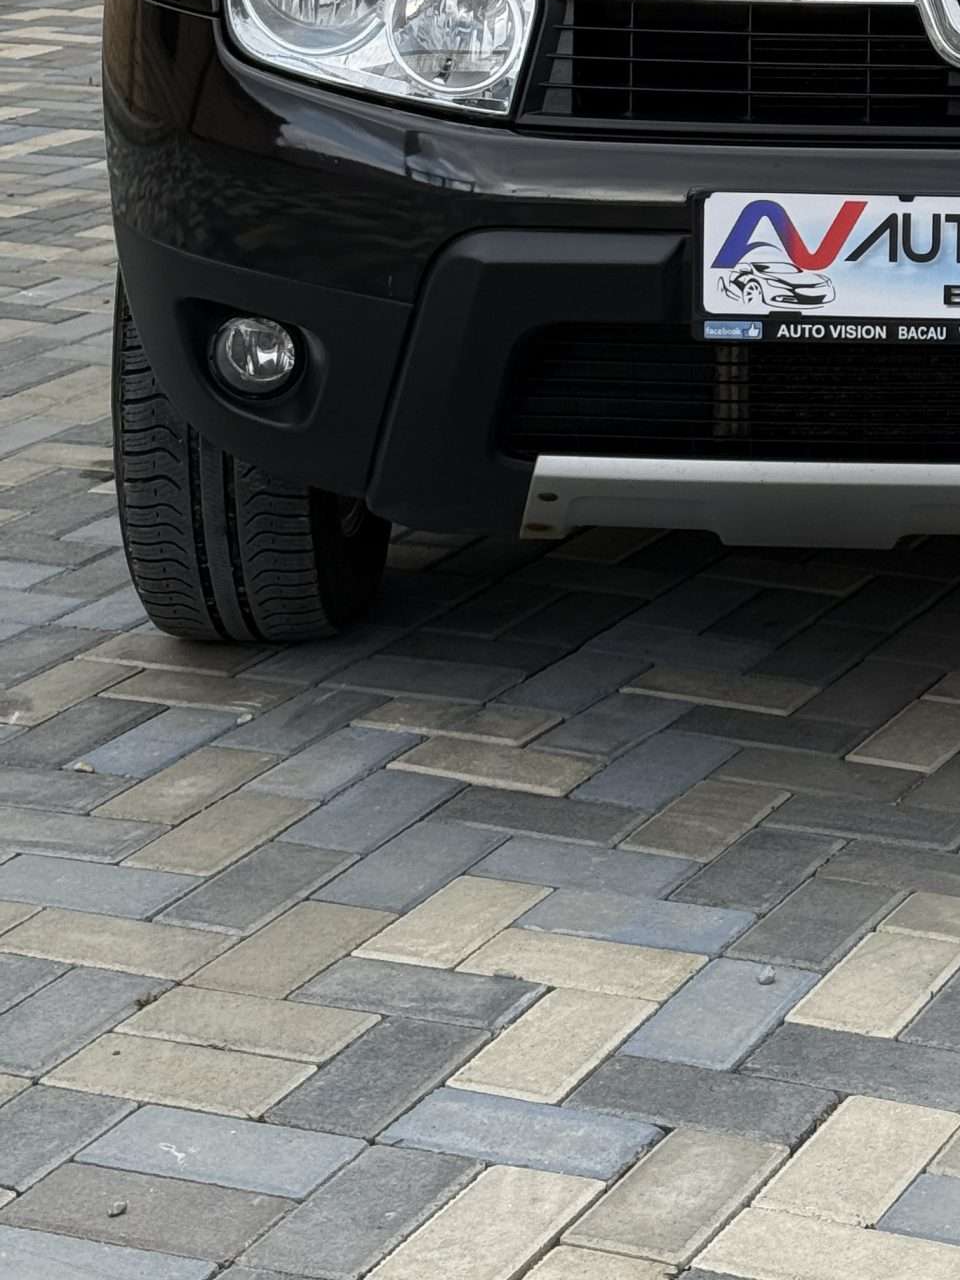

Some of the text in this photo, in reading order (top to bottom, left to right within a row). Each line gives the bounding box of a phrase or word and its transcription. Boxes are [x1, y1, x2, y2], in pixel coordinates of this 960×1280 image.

[777, 324, 826, 339] AUTO
[829, 324, 887, 340] VISION
[898, 326, 947, 341] BACAU
